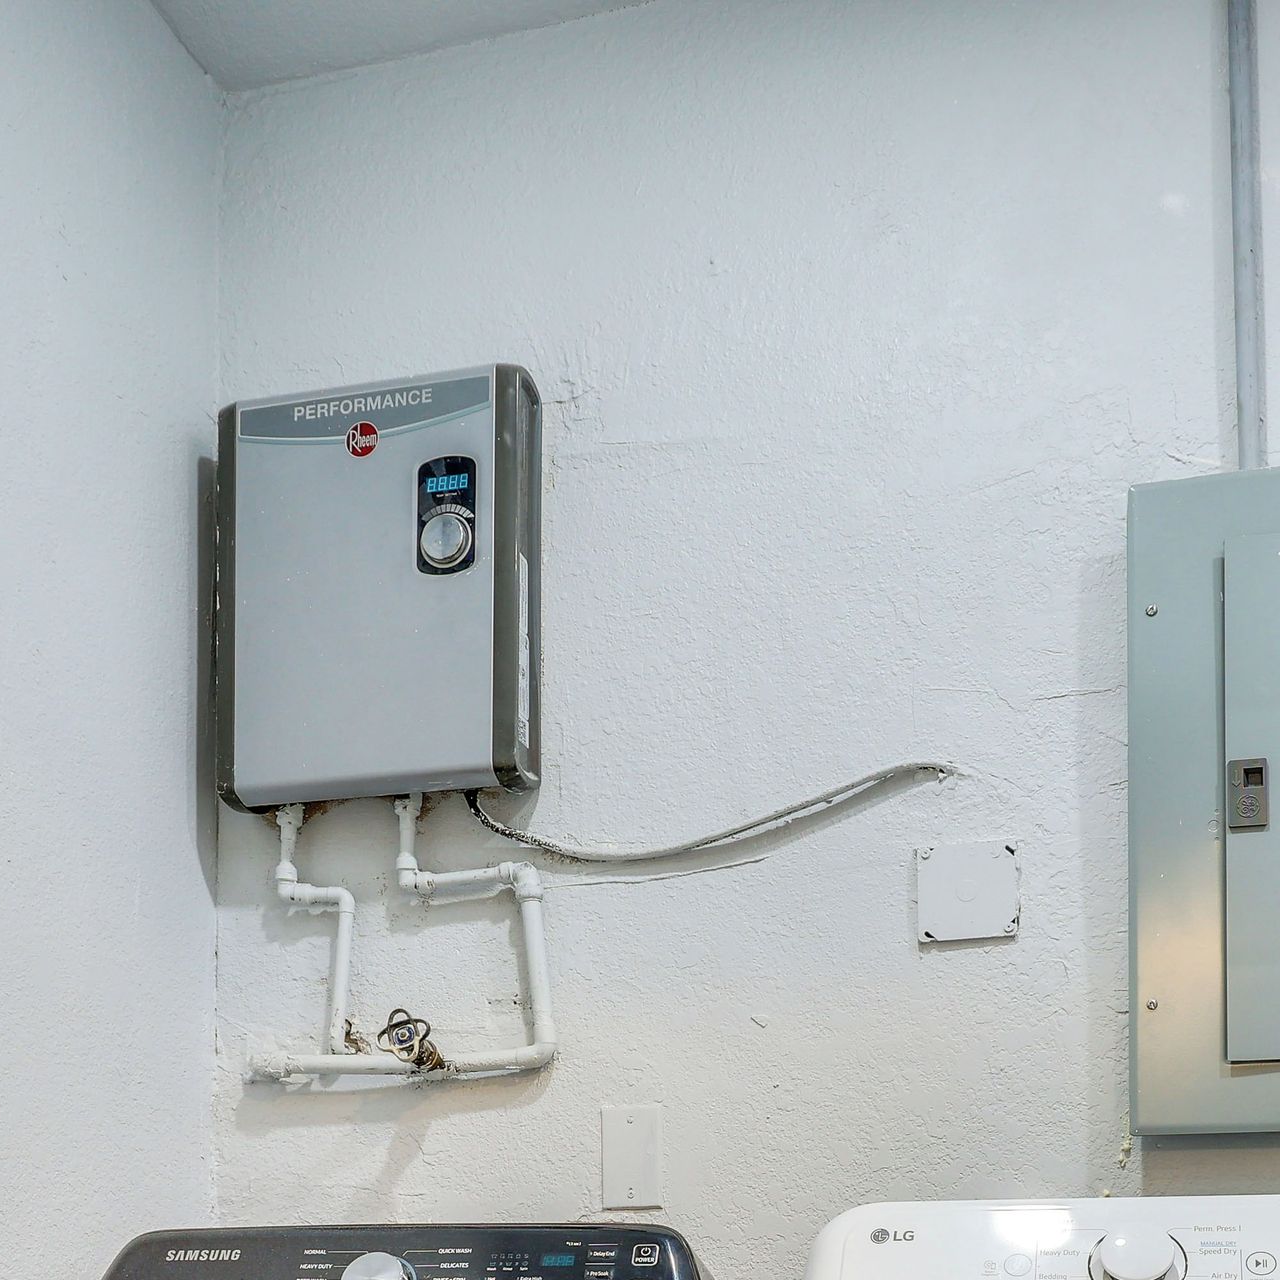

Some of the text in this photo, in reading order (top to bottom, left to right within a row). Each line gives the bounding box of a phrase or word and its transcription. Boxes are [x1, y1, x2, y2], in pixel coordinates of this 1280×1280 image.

[293, 388, 432, 422] PERFORMANCE
[349, 423, 378, 453] Rheem
[893, 1230, 916, 1242] LG
[165, 1249, 241, 1261] SAMSUNG
[1040, 1249, 1081, 1257] Heavy Duty
[1199, 1247, 1237, 1256] Speed Dry
[1038, 1273, 1067, 1280] Bedding
[1224, 1272, 1238, 1280] Dry
